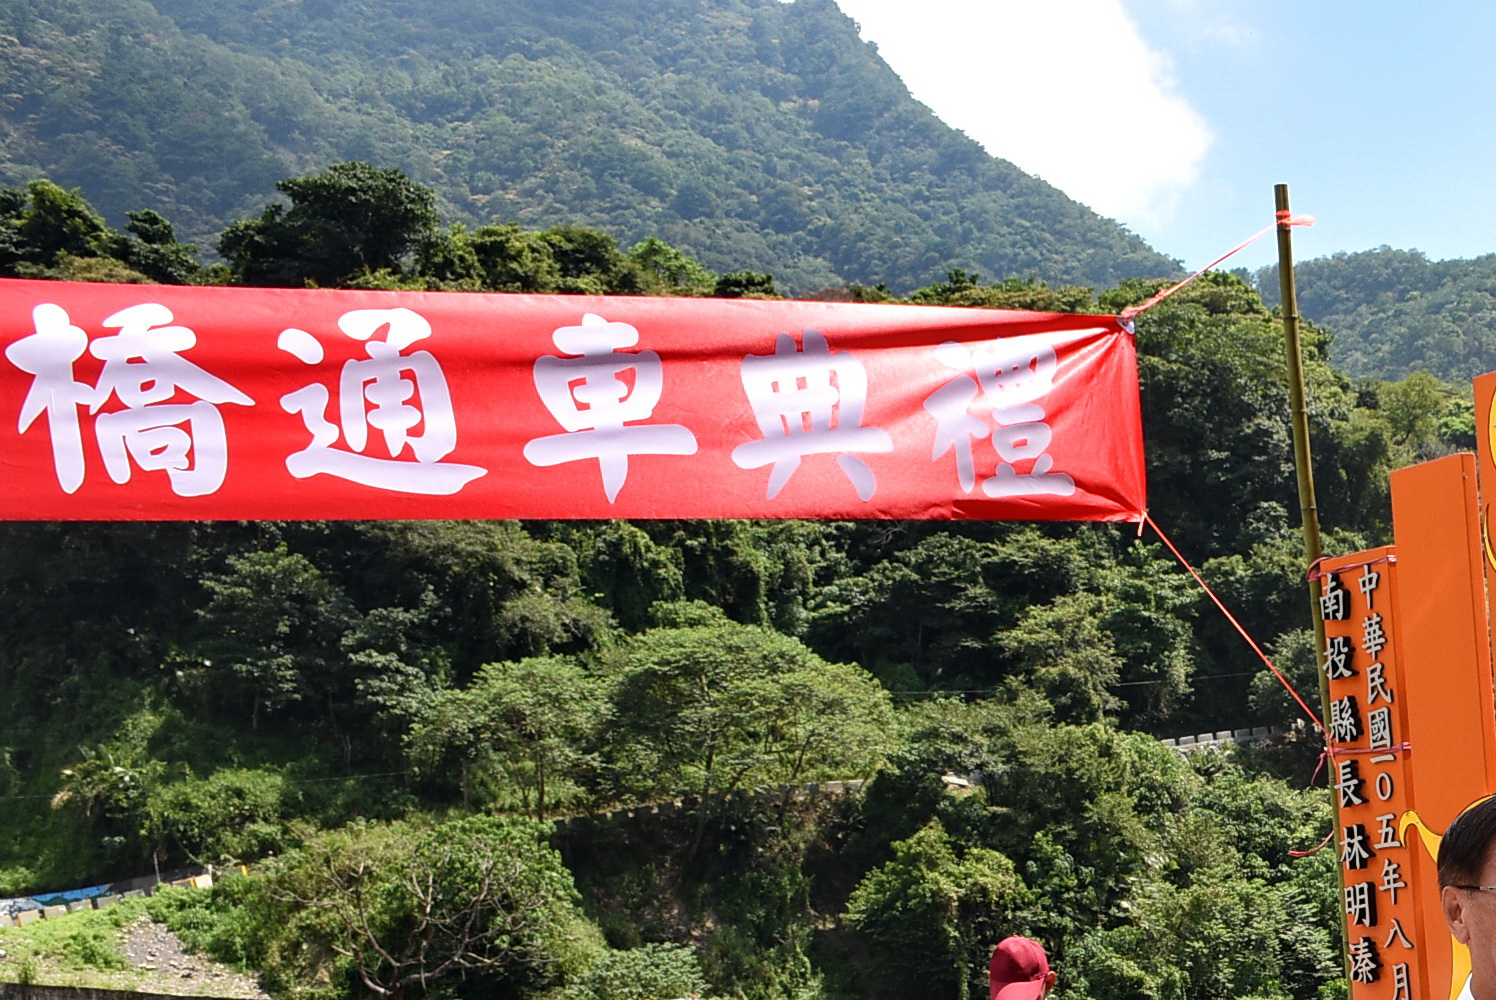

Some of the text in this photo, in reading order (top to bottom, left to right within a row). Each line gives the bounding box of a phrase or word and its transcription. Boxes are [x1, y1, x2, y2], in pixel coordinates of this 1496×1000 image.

[4, 302, 1076, 504] 橋通車典禮
[1319, 574, 1379, 984] 南投縣長林明溱
